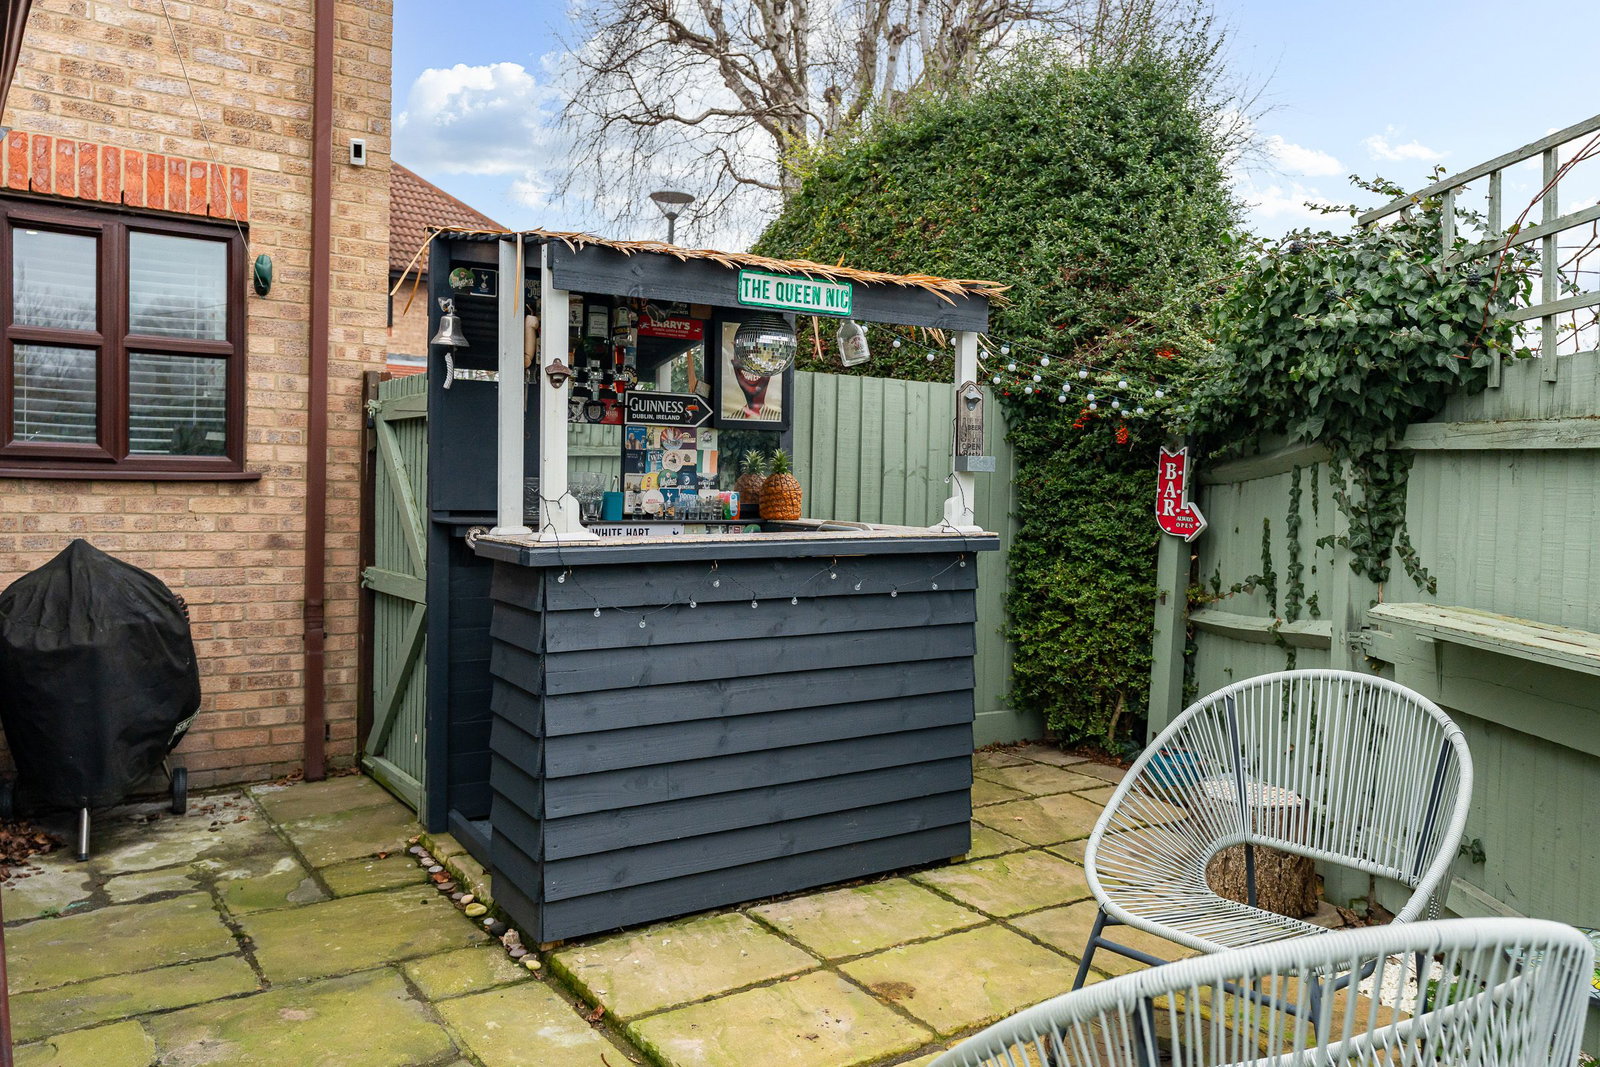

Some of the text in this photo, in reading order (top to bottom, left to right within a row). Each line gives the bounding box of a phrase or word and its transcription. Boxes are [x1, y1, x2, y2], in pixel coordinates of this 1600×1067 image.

[743, 278, 849, 309] THE QUEEN NIC
[651, 318, 691, 331] LARRY'S
[629, 397, 684, 414] GUINNESS
[1162, 463, 1176, 516] BAR
[592, 528, 650, 537] WHITE HART
